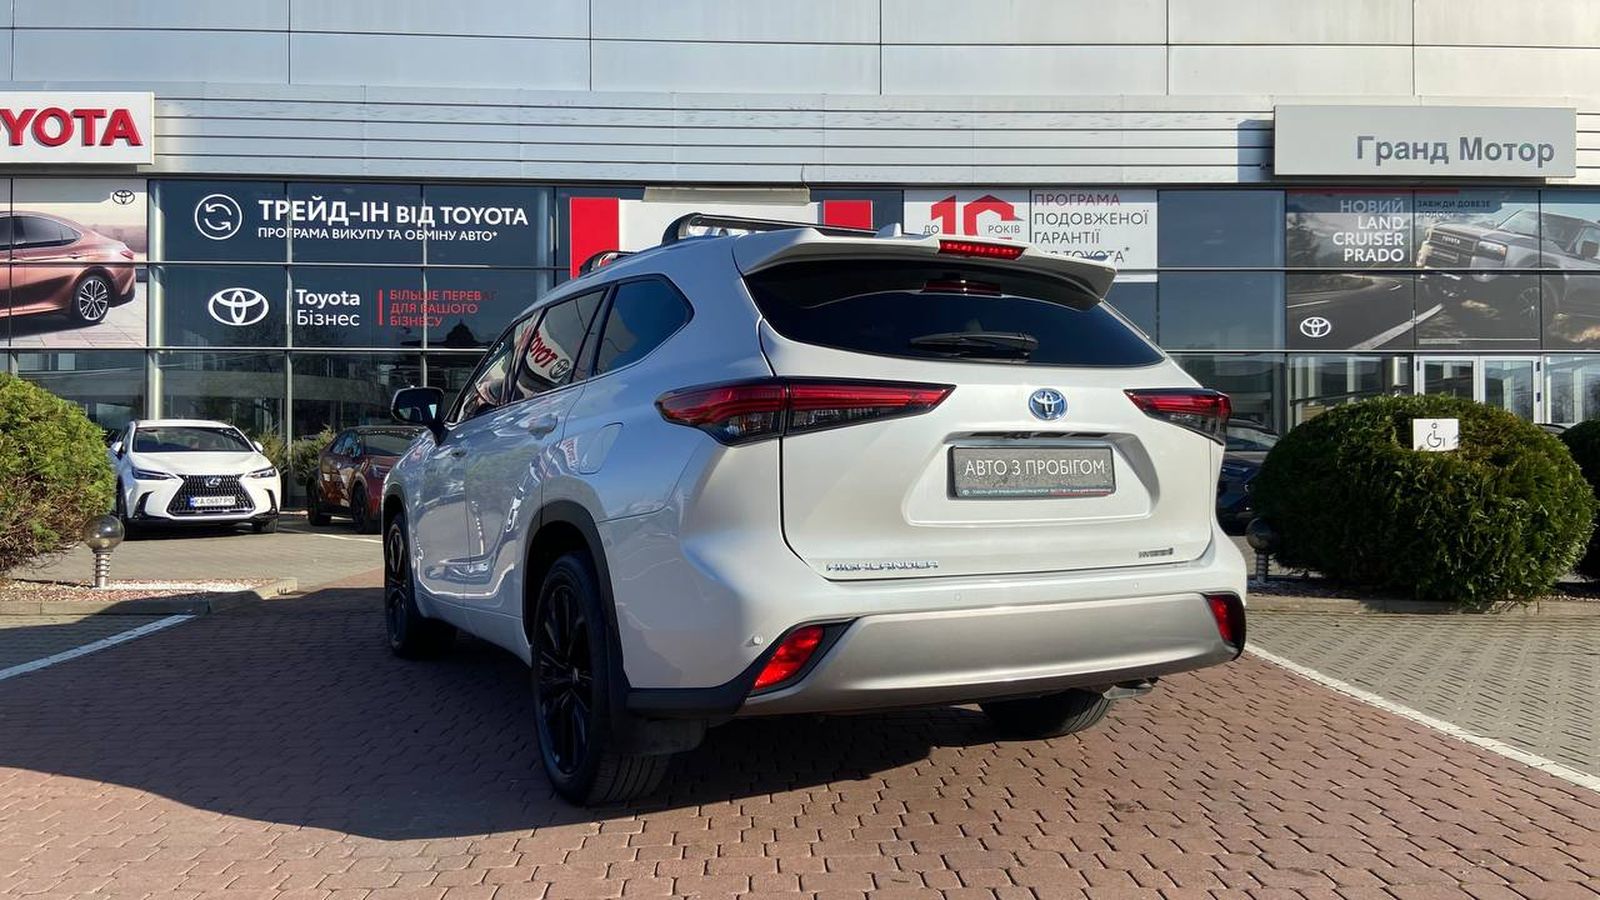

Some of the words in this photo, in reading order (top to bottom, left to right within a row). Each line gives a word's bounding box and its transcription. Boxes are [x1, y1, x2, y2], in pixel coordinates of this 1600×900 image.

[0, 107, 144, 147] YOTA
[1356, 135, 1449, 166] Гранд
[1459, 136, 1554, 168] Мотор
[1034, 193, 1121, 206] ПРОГРАМА
[1340, 199, 1404, 213] НОВИЙ
[258, 195, 389, 226] ТРЕЙД-ІН
[396, 206, 436, 227] ВІД
[440, 206, 529, 225] TOYOTA
[1034, 209, 1149, 228] ПОДОВЖЕНОЇ
[1358, 216, 1404, 230] LAND
[258, 227, 330, 239] ПРОГРАМА
[332, 228, 384, 240] ВИКУПУ
[387, 229, 402, 240] ТА
[404, 230, 457, 241] ОБМІНУ
[924, 225, 940, 235] ДО
[988, 225, 1021, 234] РОКІВ
[1034, 229, 1101, 244] ГАРАНТІЇ
[1332, 232, 1404, 246] CRUISER
[1344, 248, 1404, 262] PRADO
[295, 289, 361, 309] Toyota
[390, 304, 417, 314] ДЛЯ
[297, 310, 360, 326] Бізнес
[964, 460, 1007, 476] АВТО
[1025, 459, 1105, 475] ПРОБІГОМ
